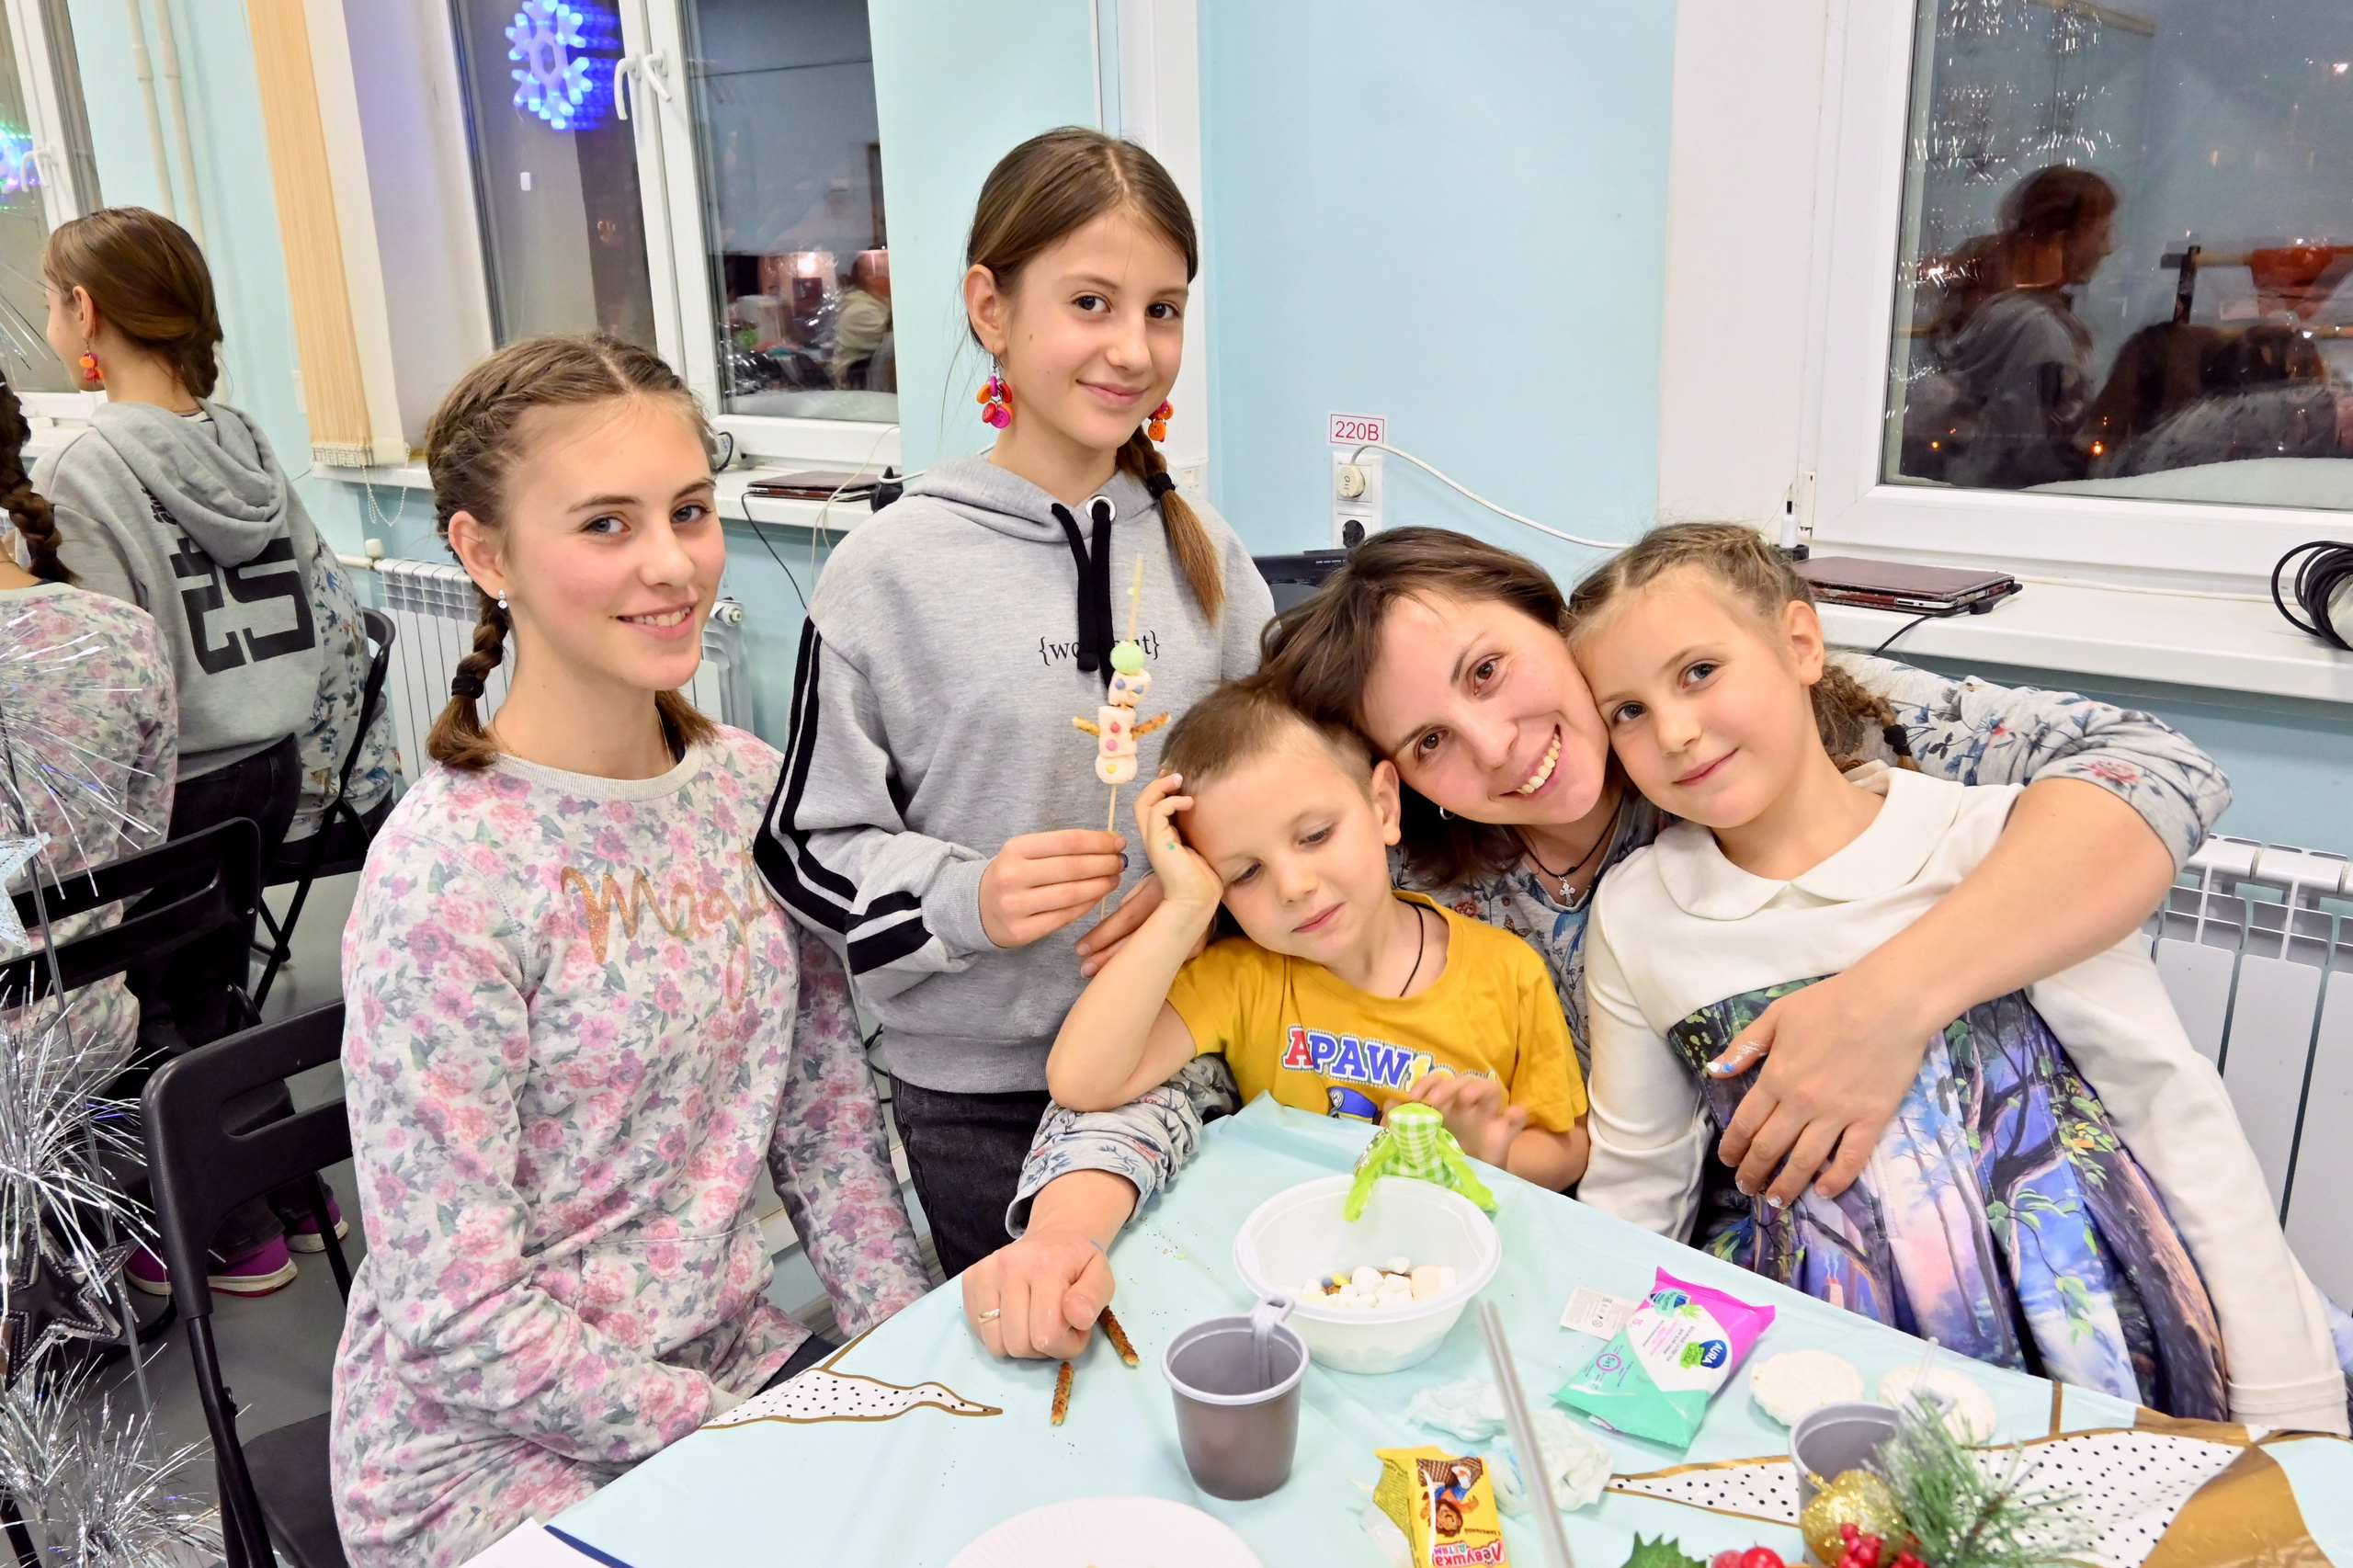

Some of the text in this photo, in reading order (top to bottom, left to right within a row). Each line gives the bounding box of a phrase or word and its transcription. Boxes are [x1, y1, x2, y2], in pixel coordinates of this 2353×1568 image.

[1335, 420, 1380, 441] 220В
[1039, 631, 1160, 666] {wot}
[1701, 1341, 1723, 1364] AURA
